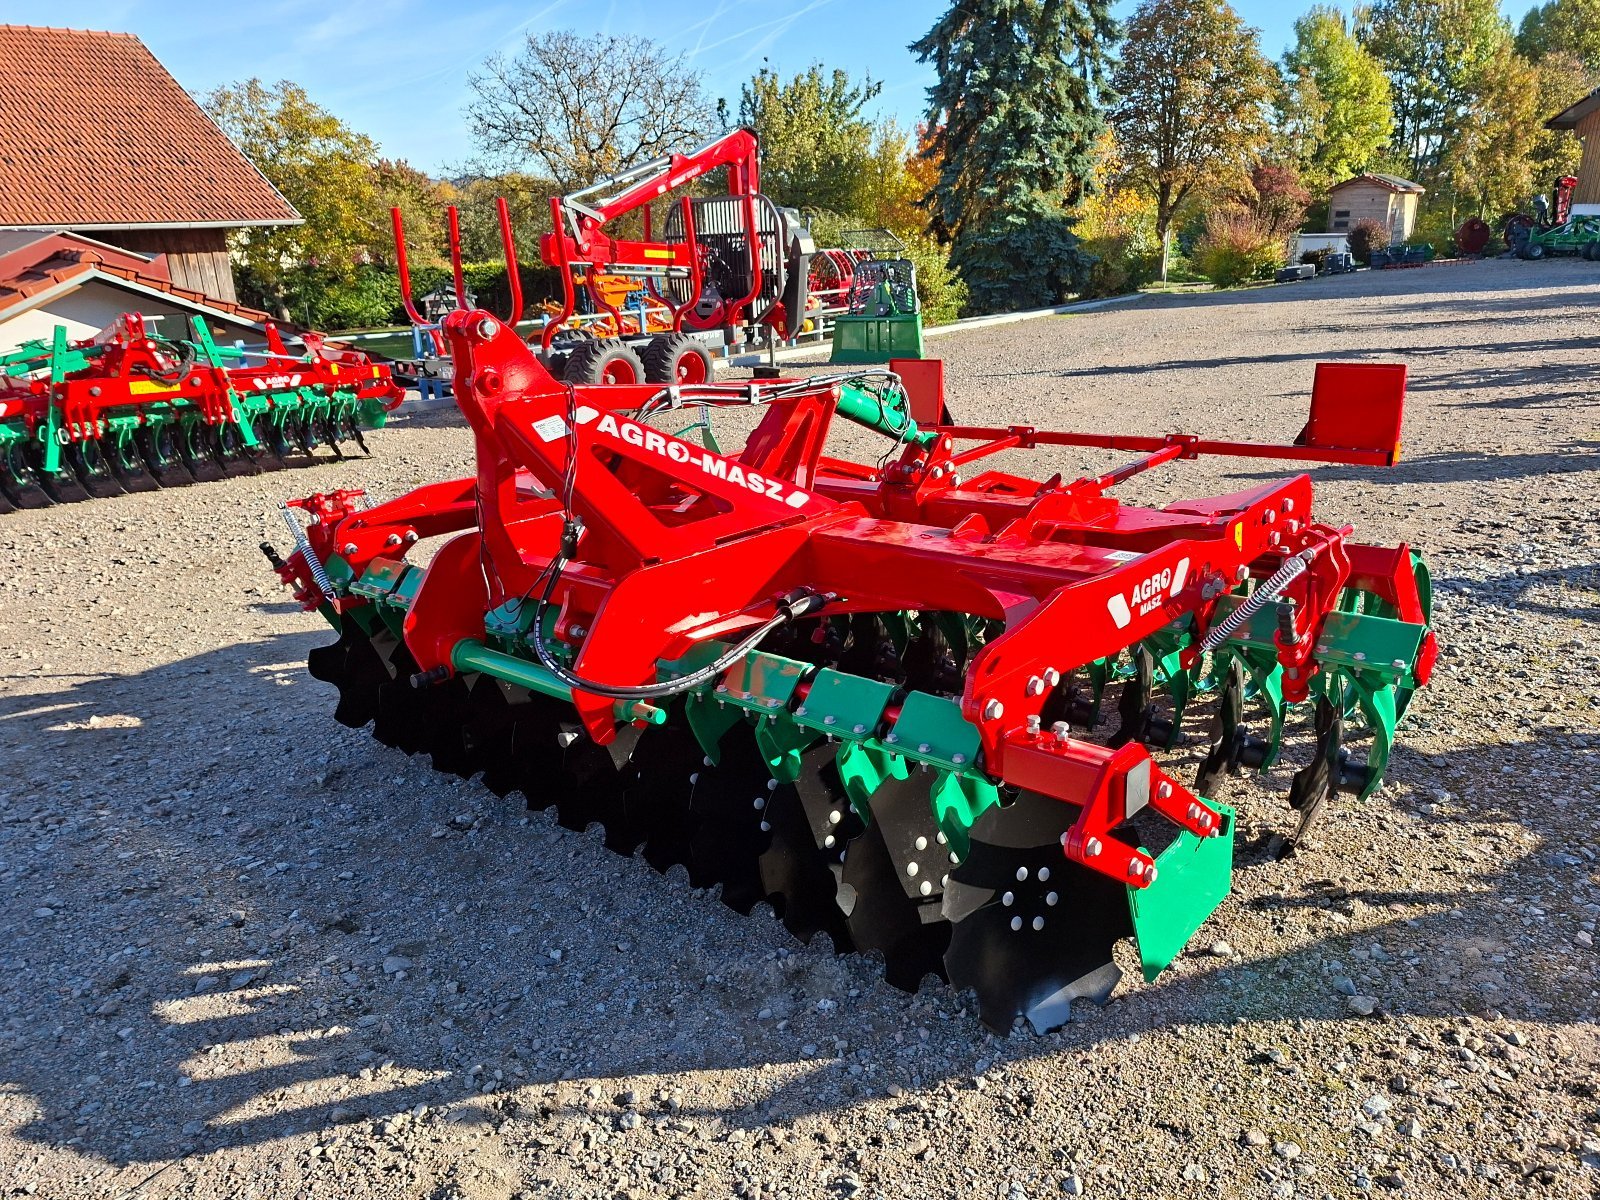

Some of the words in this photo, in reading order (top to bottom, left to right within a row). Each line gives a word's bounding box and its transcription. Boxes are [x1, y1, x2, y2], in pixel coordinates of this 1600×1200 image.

[597, 414, 785, 502] AGRO-MASZ
[1131, 567, 1171, 607] AGRO
[1140, 594, 1162, 616] MASZ
